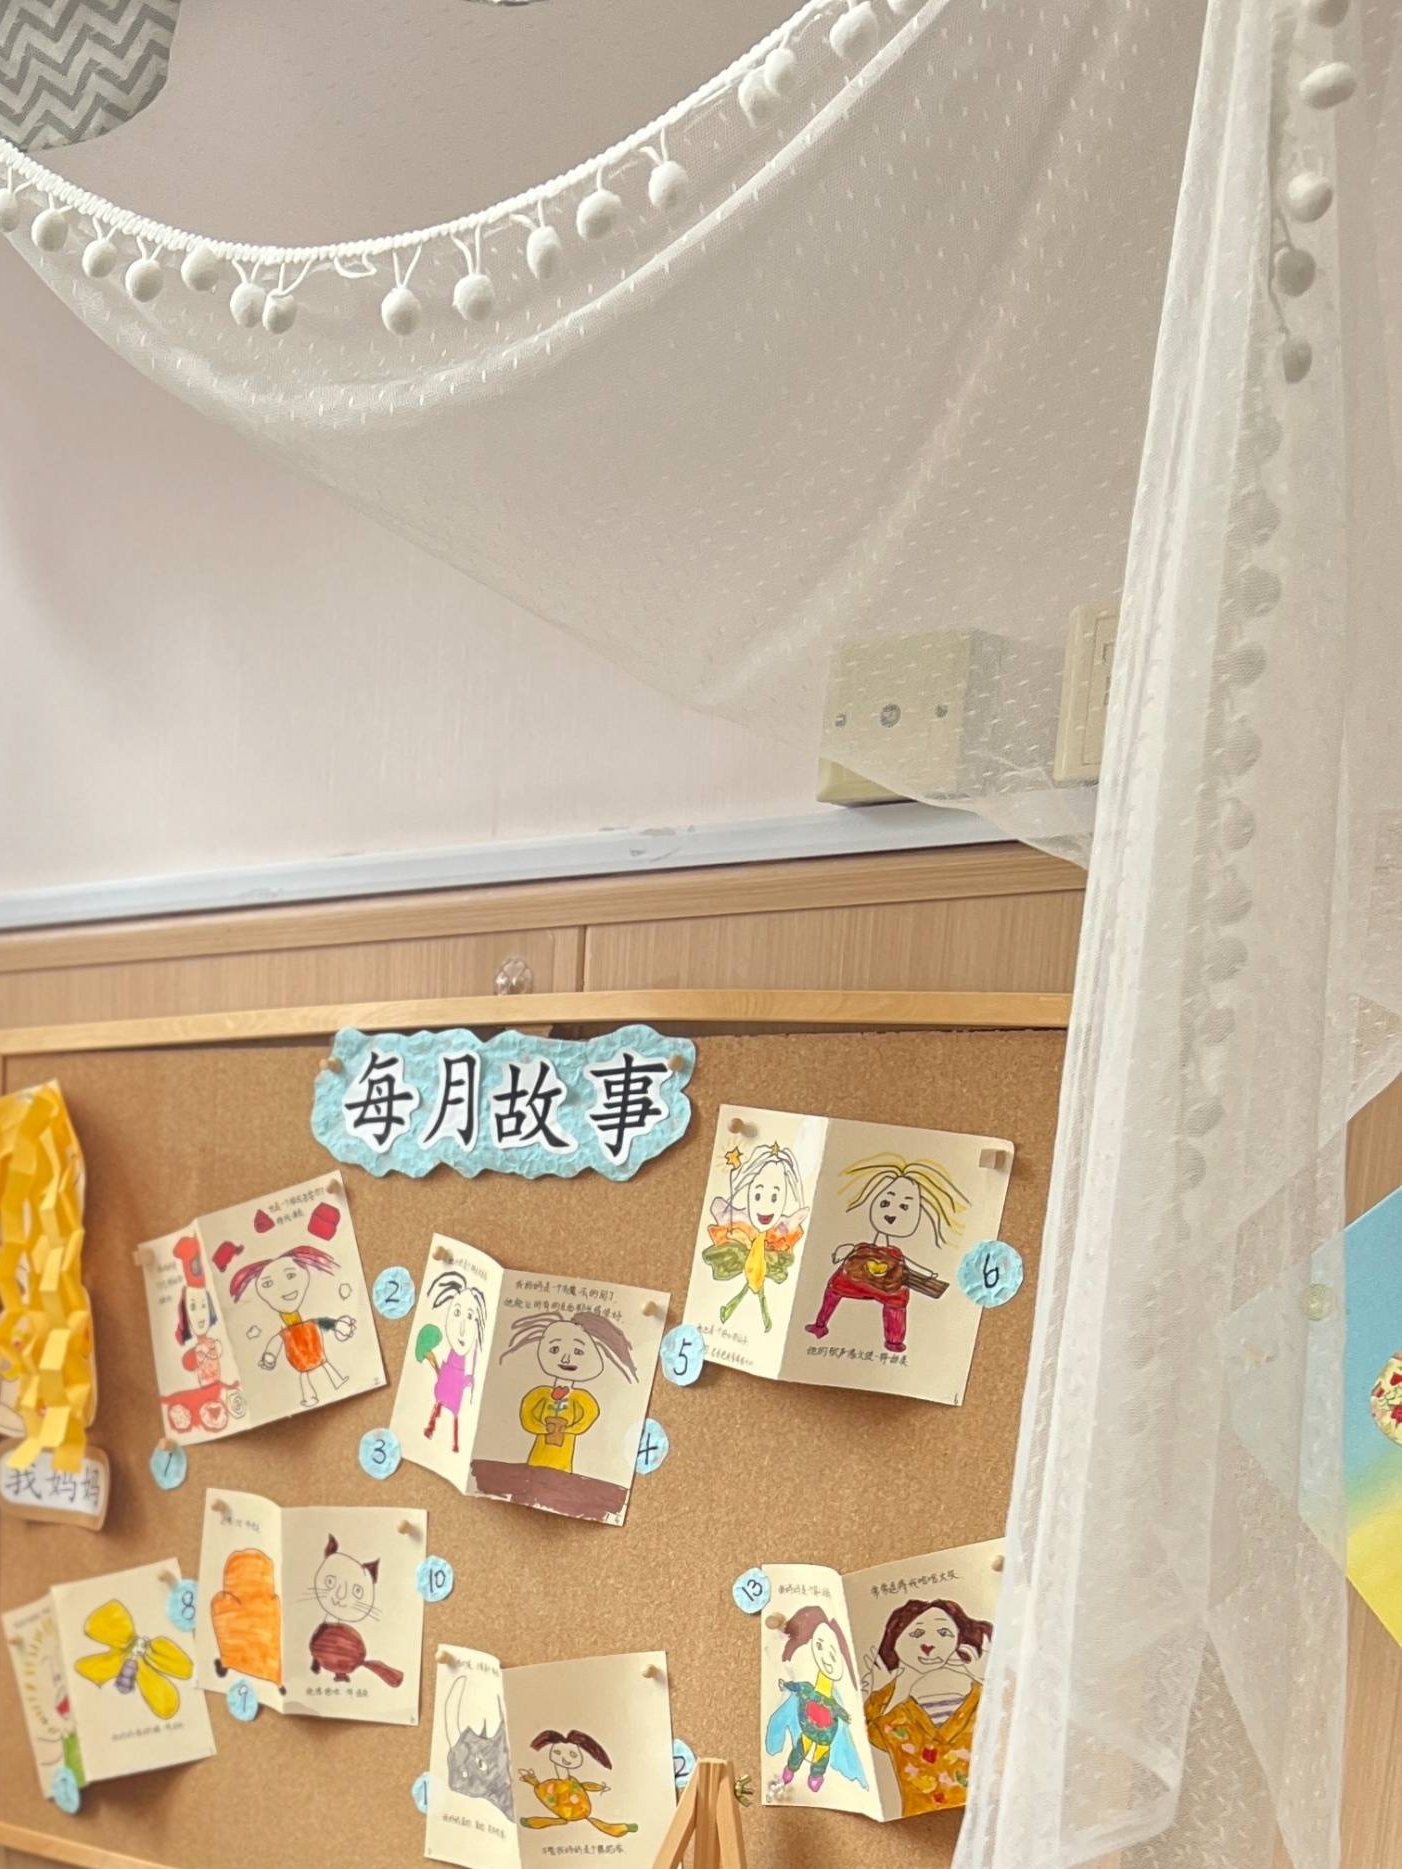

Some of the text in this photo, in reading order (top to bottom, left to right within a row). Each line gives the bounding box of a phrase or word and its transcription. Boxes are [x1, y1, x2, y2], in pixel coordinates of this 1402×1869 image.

[345, 1051, 669, 1157] 每月故事
[983, 1253, 999, 1288] 6
[384, 1280, 399, 1303] 2
[673, 1338, 692, 1375] 5
[371, 1439, 387, 1464] 3
[429, 1571, 446, 1593] 10
[741, 1579, 763, 1601] 13
[182, 1591, 196, 1621] 8
[238, 1684, 248, 1712] 9
